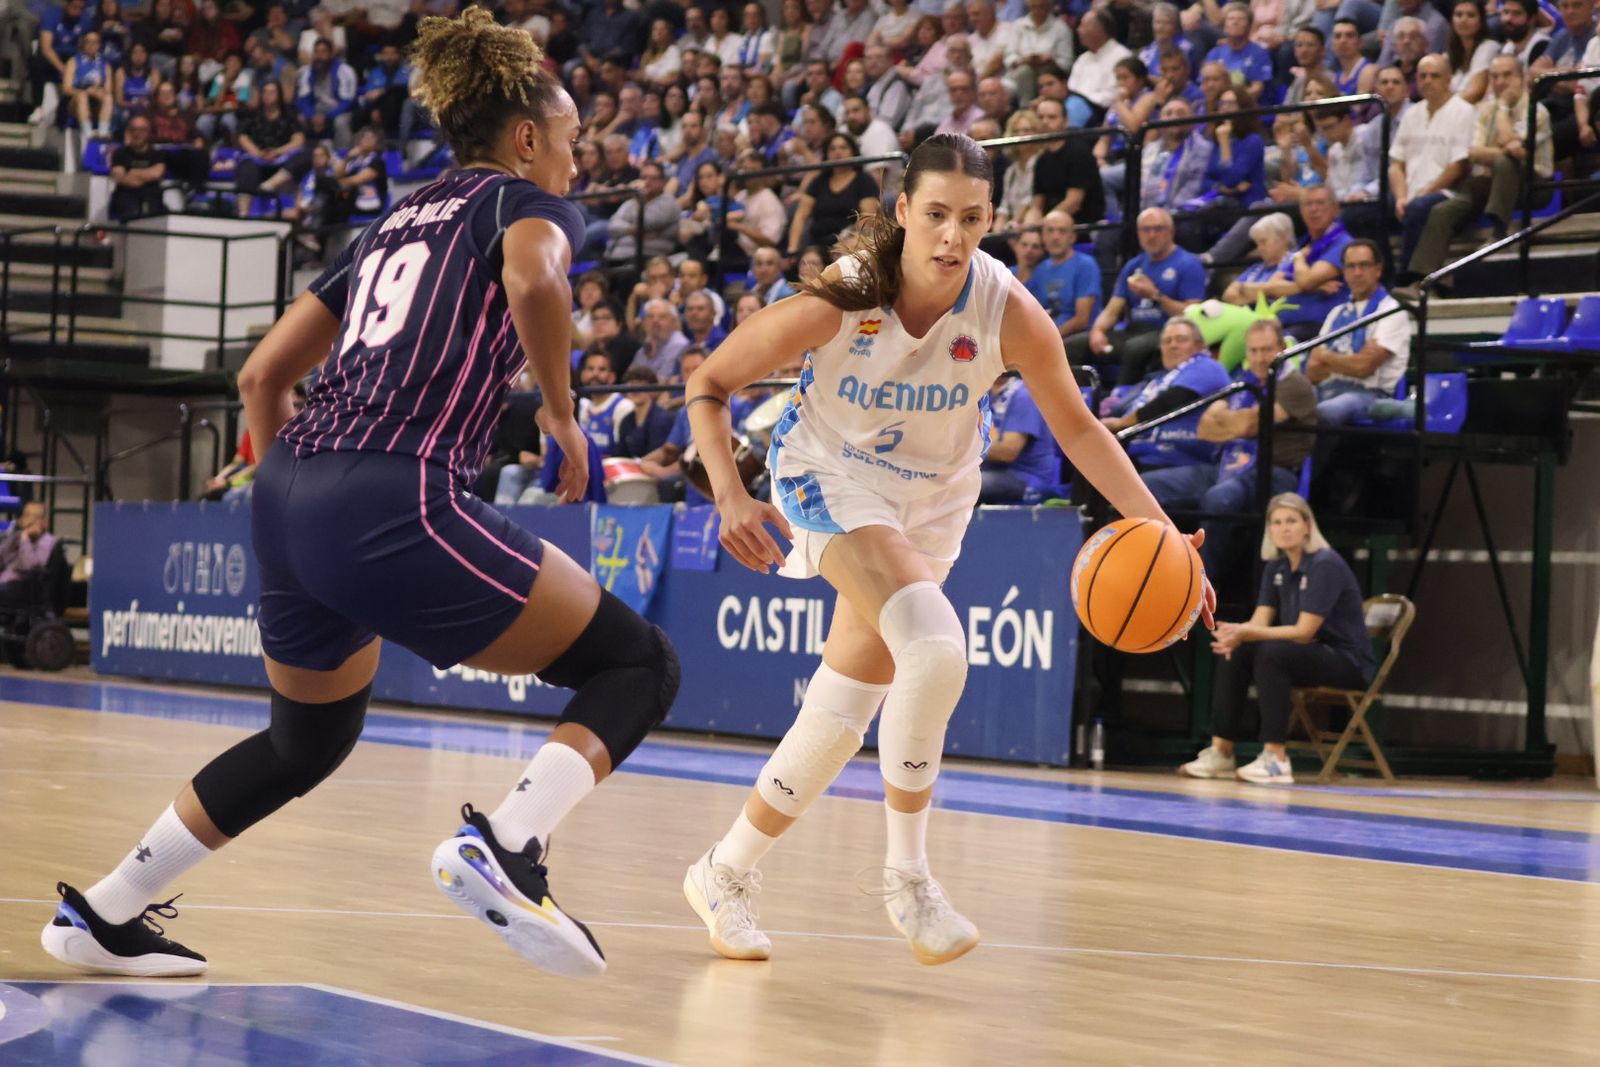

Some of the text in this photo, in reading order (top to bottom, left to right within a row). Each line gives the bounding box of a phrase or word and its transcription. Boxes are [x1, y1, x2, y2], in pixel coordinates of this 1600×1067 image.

[339, 240, 432, 357] 19
[837, 374, 970, 412] AVENIDA
[874, 420, 906, 454] 5
[716, 584, 1054, 670] CASTIL EÓN
